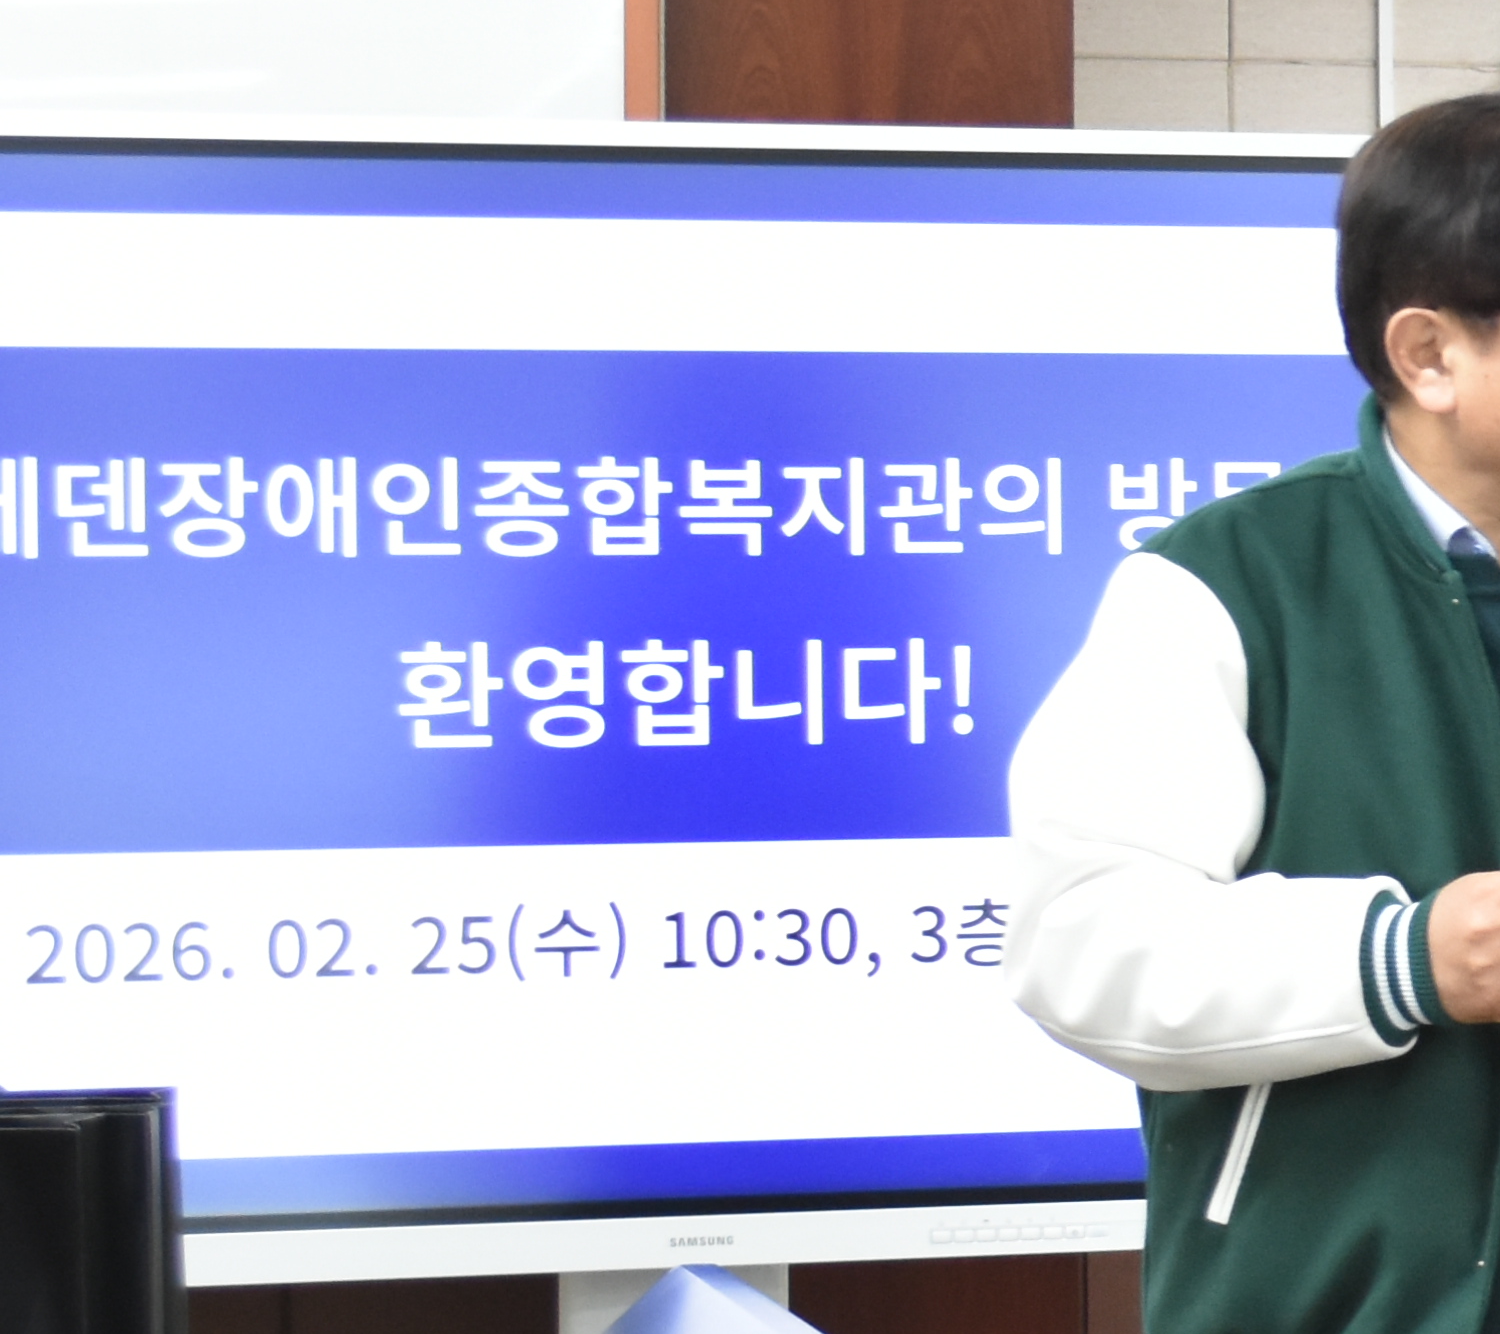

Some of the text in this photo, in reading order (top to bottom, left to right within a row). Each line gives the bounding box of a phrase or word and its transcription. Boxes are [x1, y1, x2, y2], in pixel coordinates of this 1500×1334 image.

[397, 637, 974, 749] 환영합니다!
[26, 898, 1009, 986] 2026. 02. 25(수) 10:30, 3층
[669, 1236, 734, 1247] SAMSUNG
